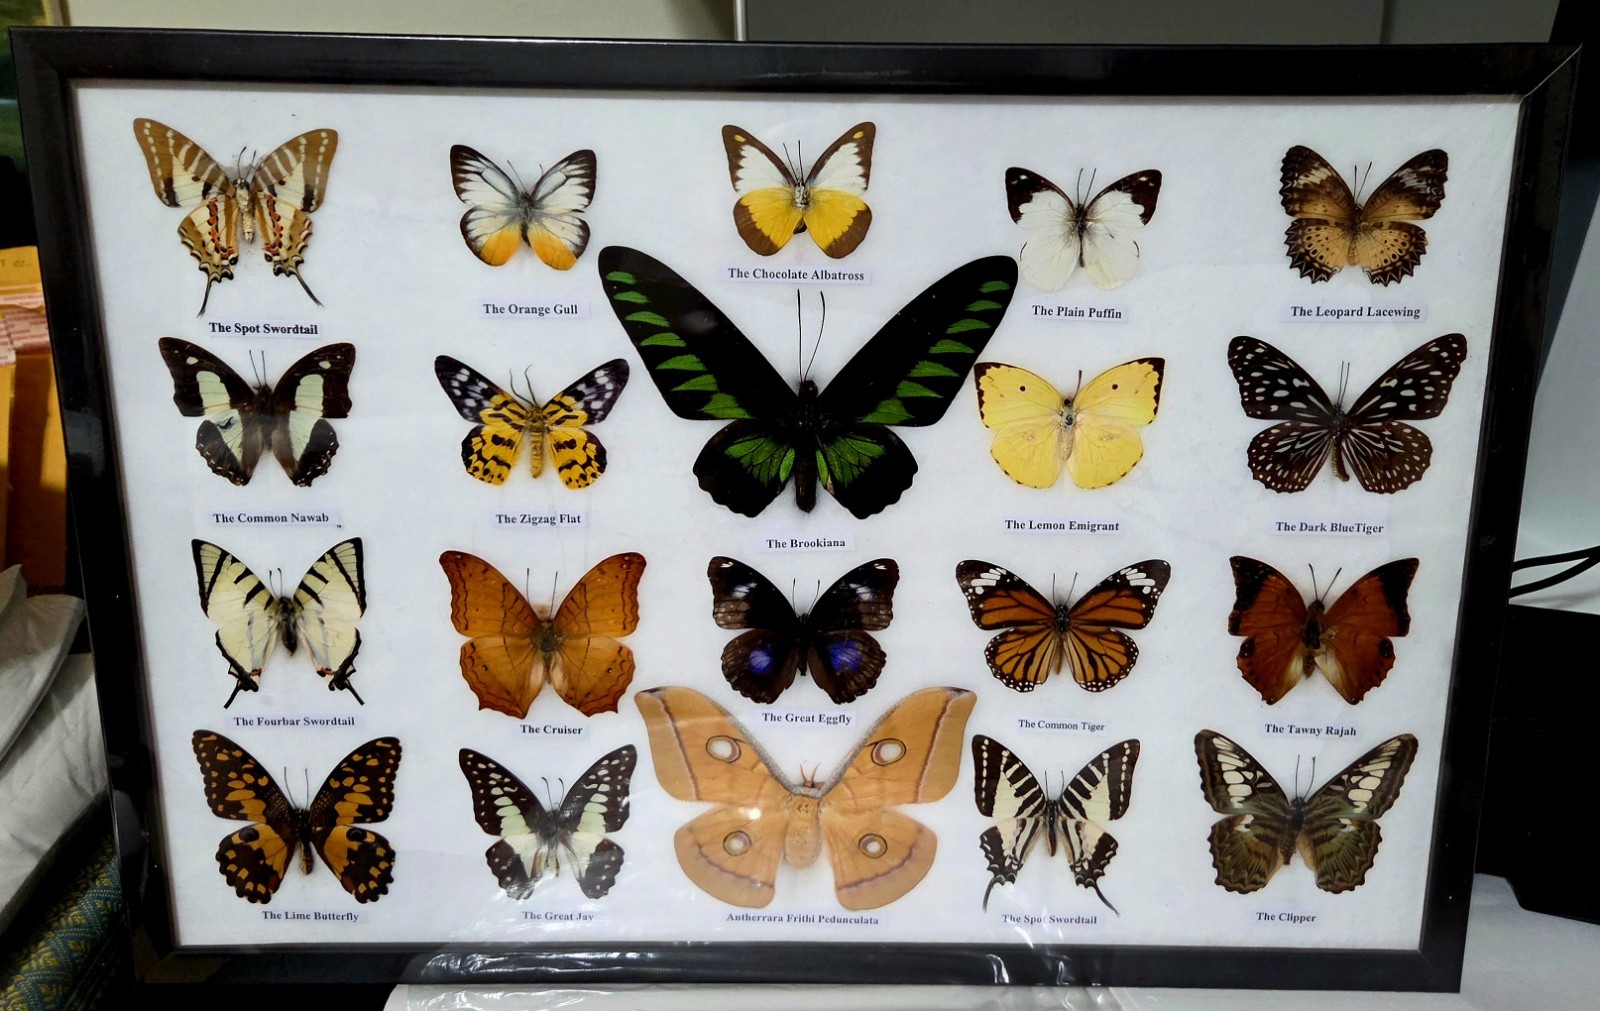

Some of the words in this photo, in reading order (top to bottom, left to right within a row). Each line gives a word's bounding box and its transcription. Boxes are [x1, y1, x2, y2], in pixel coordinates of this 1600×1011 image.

[728, 267, 750, 279] The
[753, 268, 808, 280] Chocolate
[812, 269, 865, 281] Albatross
[483, 303, 506, 314] The
[509, 303, 551, 317] Orange
[554, 304, 578, 315] Gull
[1032, 304, 1054, 316] The
[1057, 306, 1085, 318] Plain
[1089, 307, 1122, 319] Puffin
[1291, 306, 1313, 317] The
[1316, 306, 1364, 320] Leopard
[1367, 306, 1421, 320] Lacewing
[209, 322, 232, 333] The
[234, 322, 261, 336] Spot
[263, 323, 319, 335] Swordtail
[213, 513, 235, 524] The
[238, 513, 288, 523] Common
[291, 512, 329, 523] Nawab
[496, 514, 517, 524] The
[520, 513, 557, 526] Zigzag
[560, 513, 581, 524] Flat
[1005, 519, 1026, 530] The
[1030, 520, 1066, 530] Lemon
[1069, 520, 1120, 533] Emigrant
[1276, 521, 1297, 532] The
[1300, 522, 1327, 532] Dark
[766, 538, 788, 550] The
[790, 537, 847, 549] Brookiana
[234, 717, 254, 727] The
[257, 716, 301, 726] Fourbar
[304, 716, 355, 726] Swordtail
[762, 711, 784, 723] The
[785, 712, 816, 724] Great
[819, 713, 853, 727] Eggfly
[521, 724, 542, 736] The
[543, 724, 584, 736] Cruiser
[1019, 719, 1036, 729] The
[1038, 720, 1079, 730] Common
[1082, 721, 1105, 733] Tiger
[1265, 723, 1285, 734] The
[1288, 724, 1323, 738] Tawny
[1326, 725, 1357, 738] Rajah
[263, 910, 282, 920] The
[285, 911, 311, 920] Lime
[314, 911, 359, 923] Butterfly
[522, 910, 543, 921] The
[545, 911, 574, 921] Great
[576, 911, 595, 923] Jay
[727, 912, 784, 923] Antherrara
[787, 913, 816, 924] Frithi
[819, 914, 880, 926] Pedunculata
[1002, 914, 1022, 923] The
[1050, 915, 1098, 925] Swordtail
[1256, 912, 1276, 921] The
[1279, 912, 1317, 924] Clipper
